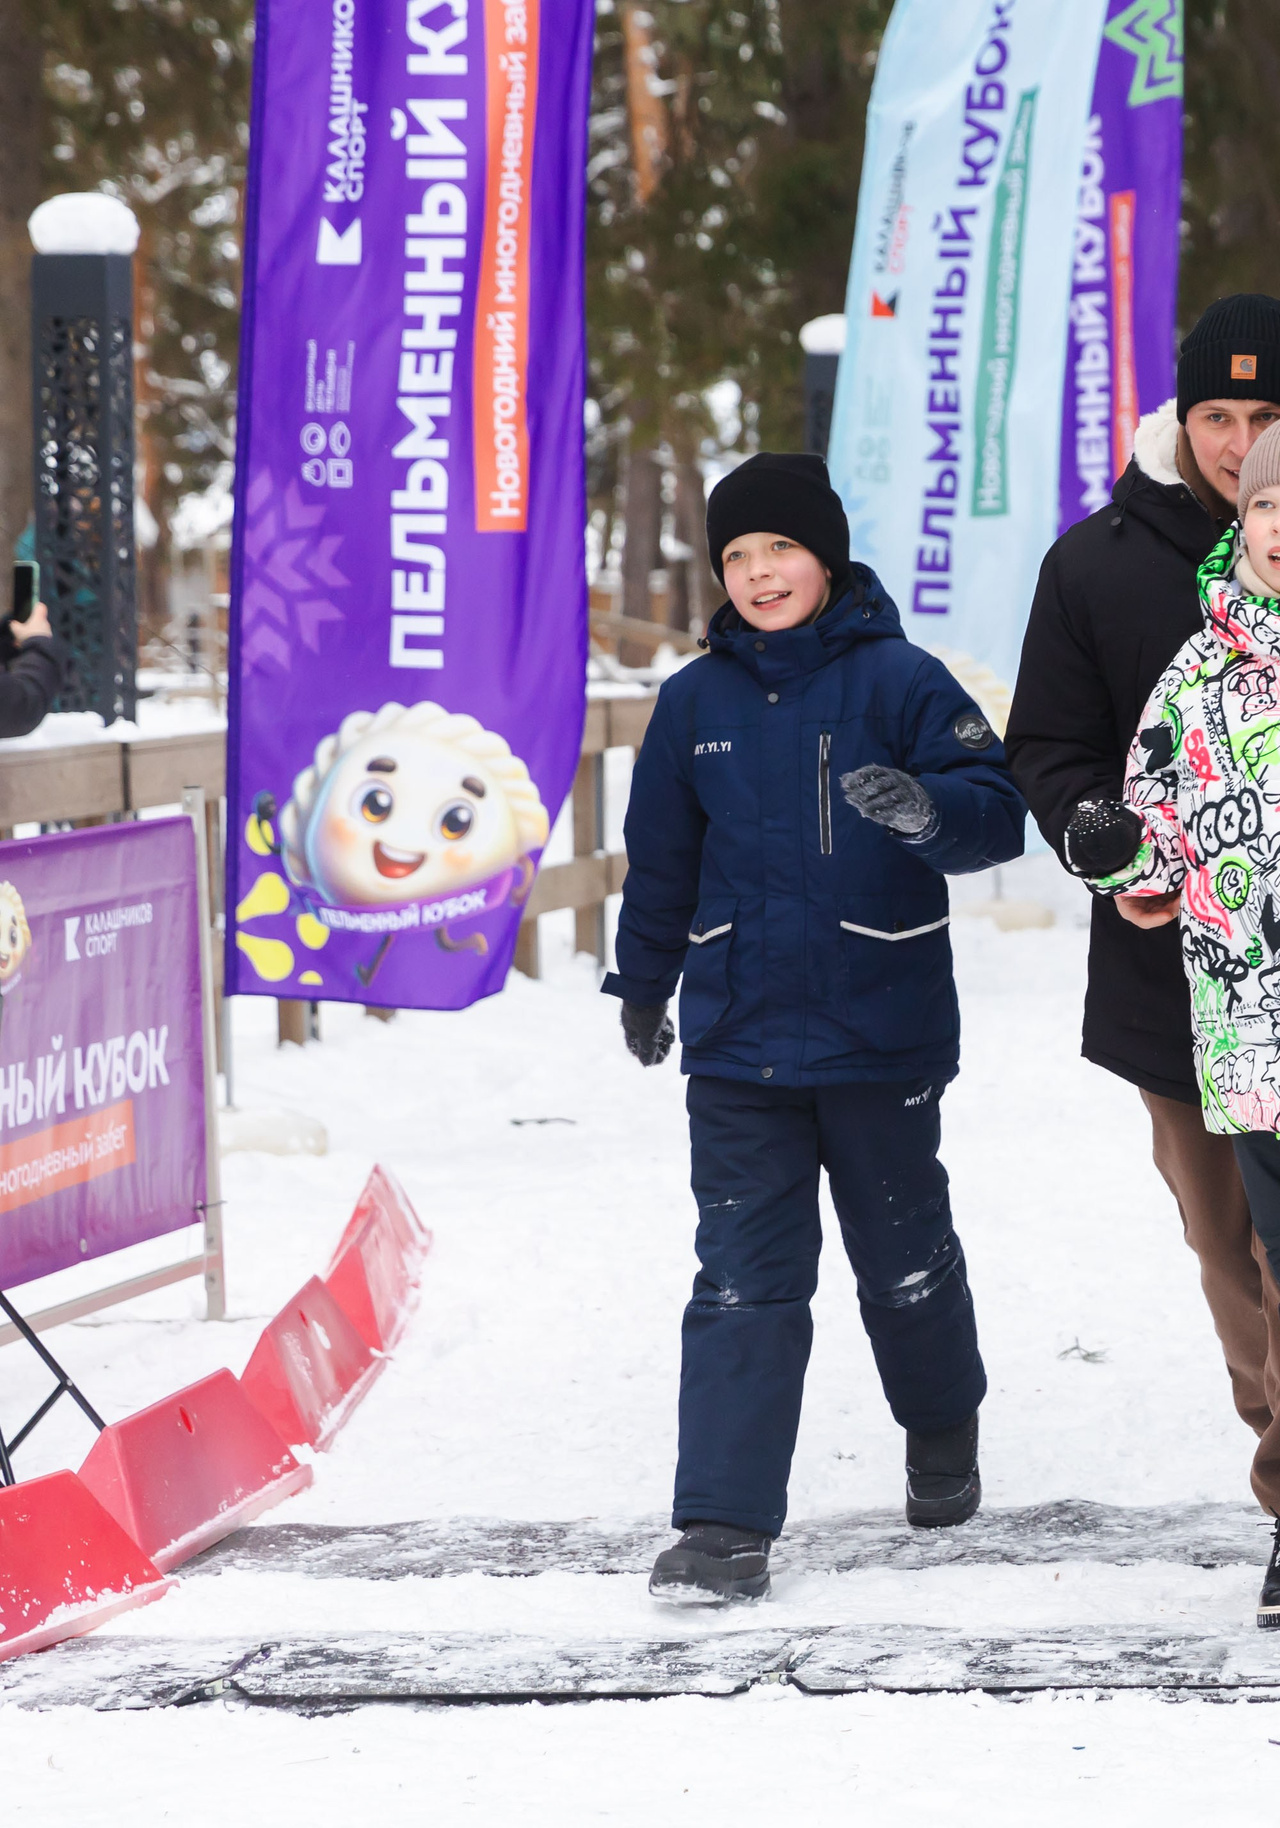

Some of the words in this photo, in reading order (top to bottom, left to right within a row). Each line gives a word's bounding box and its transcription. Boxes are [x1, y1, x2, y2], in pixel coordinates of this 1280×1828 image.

[344, 97, 369, 202] СПОРТ
[494, 51, 527, 303] многодневный
[389, 98, 468, 669] ПЕЛЬМЕННЫЙ
[487, 311, 521, 518] Новогодний
[911, 205, 979, 616] ПЕЛЬМЕННЫЙ
[84, 903, 153, 934] КАЛАШНИКОВ
[85, 932, 119, 958] СПОРТ
[73, 1024, 170, 1110] КУБОК
[96, 1119, 128, 1159] забег
